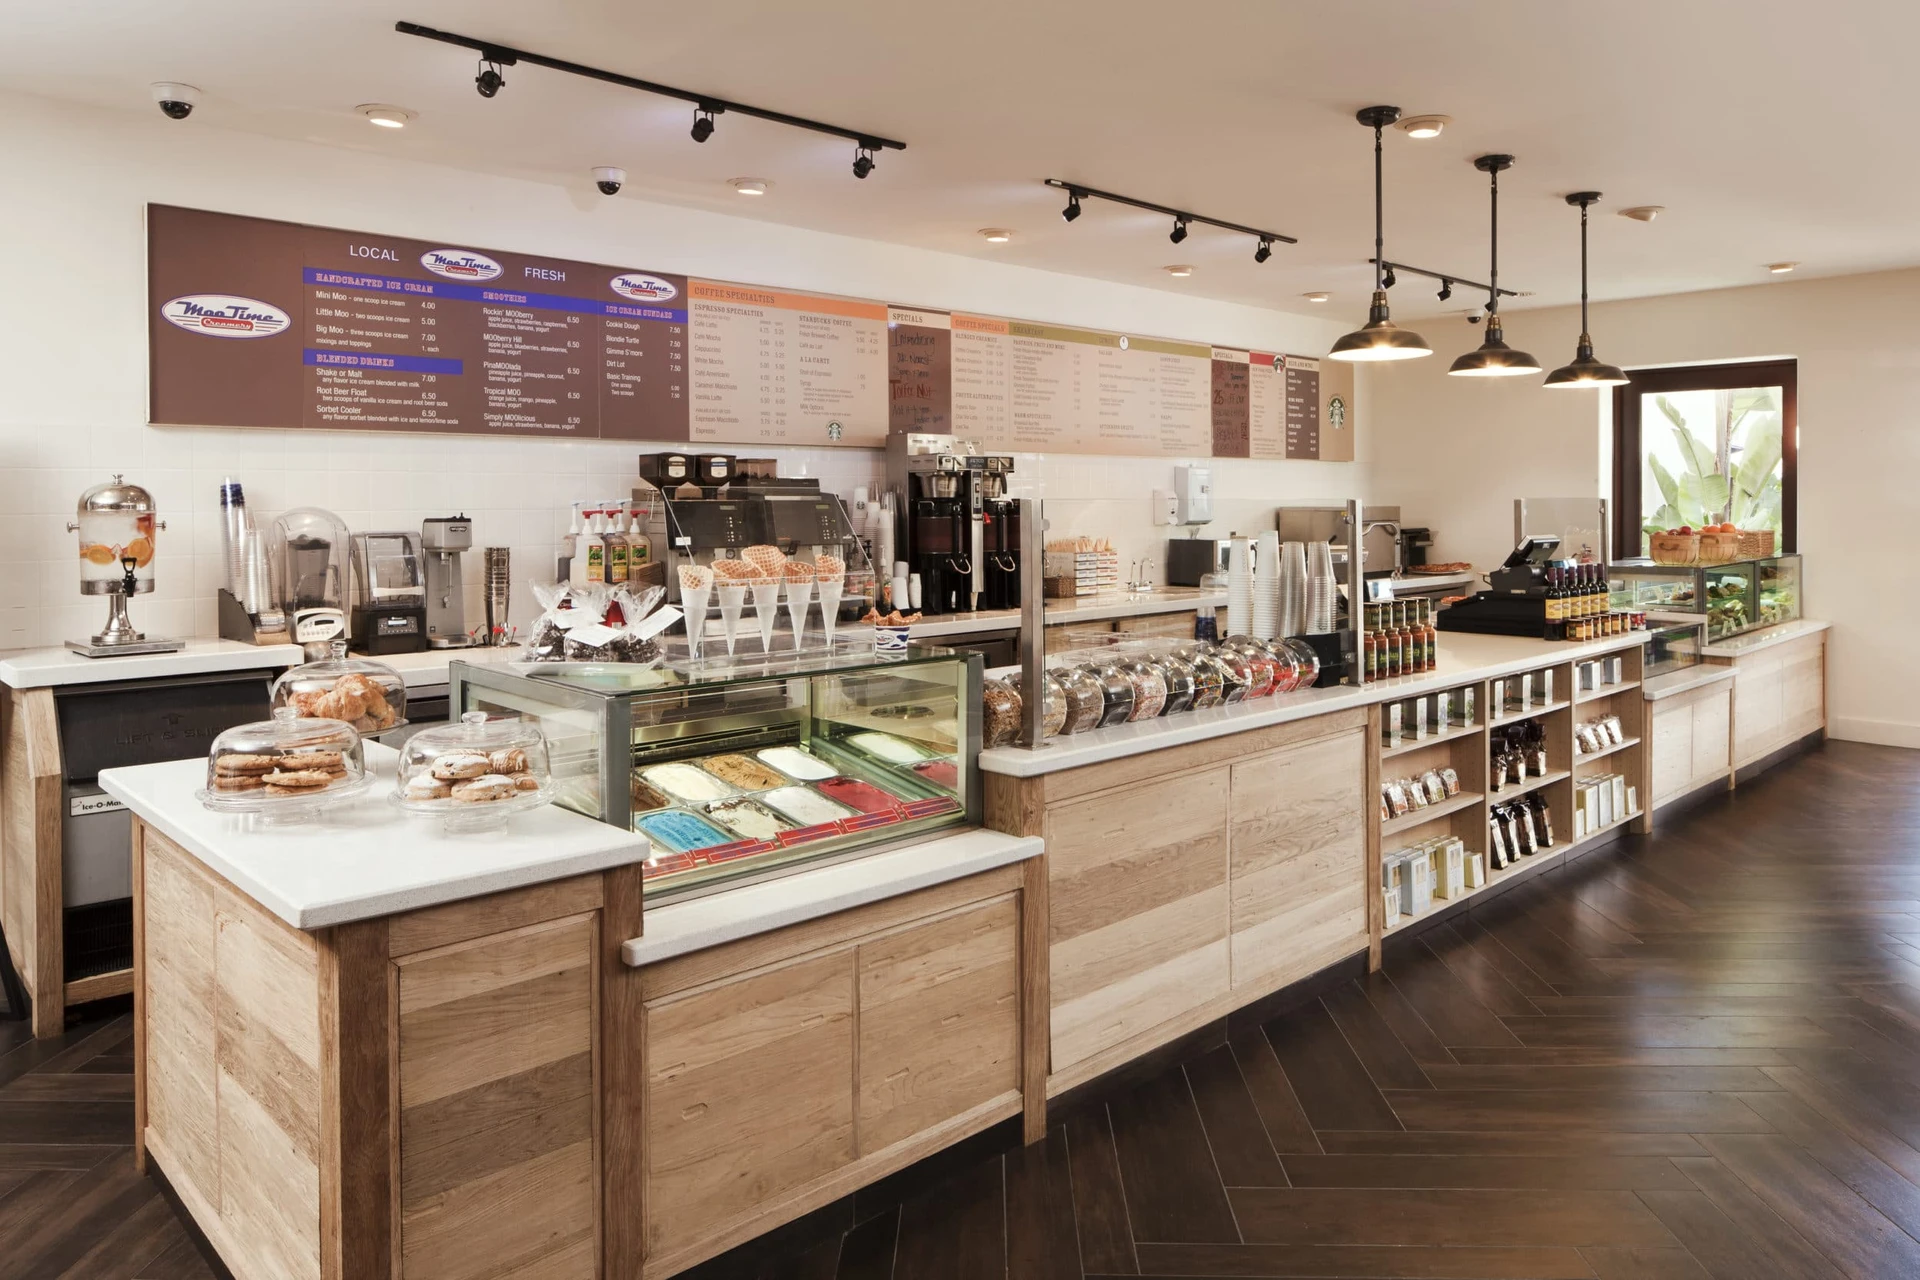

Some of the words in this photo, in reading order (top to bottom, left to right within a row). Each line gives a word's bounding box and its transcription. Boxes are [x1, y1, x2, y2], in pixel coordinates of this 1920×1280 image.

[350, 245, 399, 261] LOCAL
[430, 254, 460, 265] Moo
[461, 258, 497, 270] Time
[525, 268, 565, 281] FRESH
[316, 273, 383, 287] HANDCRAFTED
[386, 282, 400, 290] ICE
[404, 285, 433, 293] CREAM
[618, 278, 642, 288] Moo
[643, 281, 672, 292] Time
[316, 291, 330, 300] Mini
[332, 292, 347, 301] Moo
[483, 292, 527, 303] SMOOTHIES
[695, 287, 724, 298] COFFEE
[727, 291, 774, 304] SPECIALTIES
[421, 302, 435, 310] 4.00
[695, 304, 725, 314] ESPRESSO
[727, 308, 763, 317] SPECIALTIES
[176, 301, 226, 317] Moo
[226, 306, 284, 323] Time
[316, 308, 333, 317] Little
[334, 310, 349, 318] Moo
[506, 310, 533, 319] MOOberry
[619, 307, 641, 316] CREAM
[643, 309, 672, 319] SUNDAES
[799, 315, 831, 324] STARBUCKS
[893, 313, 922, 322] SPECIALS
[204, 319, 251, 330] Creamery
[624, 322, 640, 330] Dough
[316, 325, 327, 334] Big
[484, 334, 512, 342] MOOberry
[606, 335, 625, 343] Blondie
[350, 340, 371, 348] toppings
[606, 347, 624, 355] Gimme
[695, 345, 721, 353] Cappuccino
[317, 354, 358, 364] BLENDED
[360, 357, 394, 367] DRINKS
[317, 368, 338, 377] Shake
[621, 374, 641, 382] Training
[317, 387, 331, 395] Root
[484, 387, 505, 395] Tropical
[317, 405, 338, 413] Sorbet
[484, 413, 502, 421] Simply
[505, 414, 535, 422] MOOlicious
[82, 800, 124, 810] Ice-O-Ma
